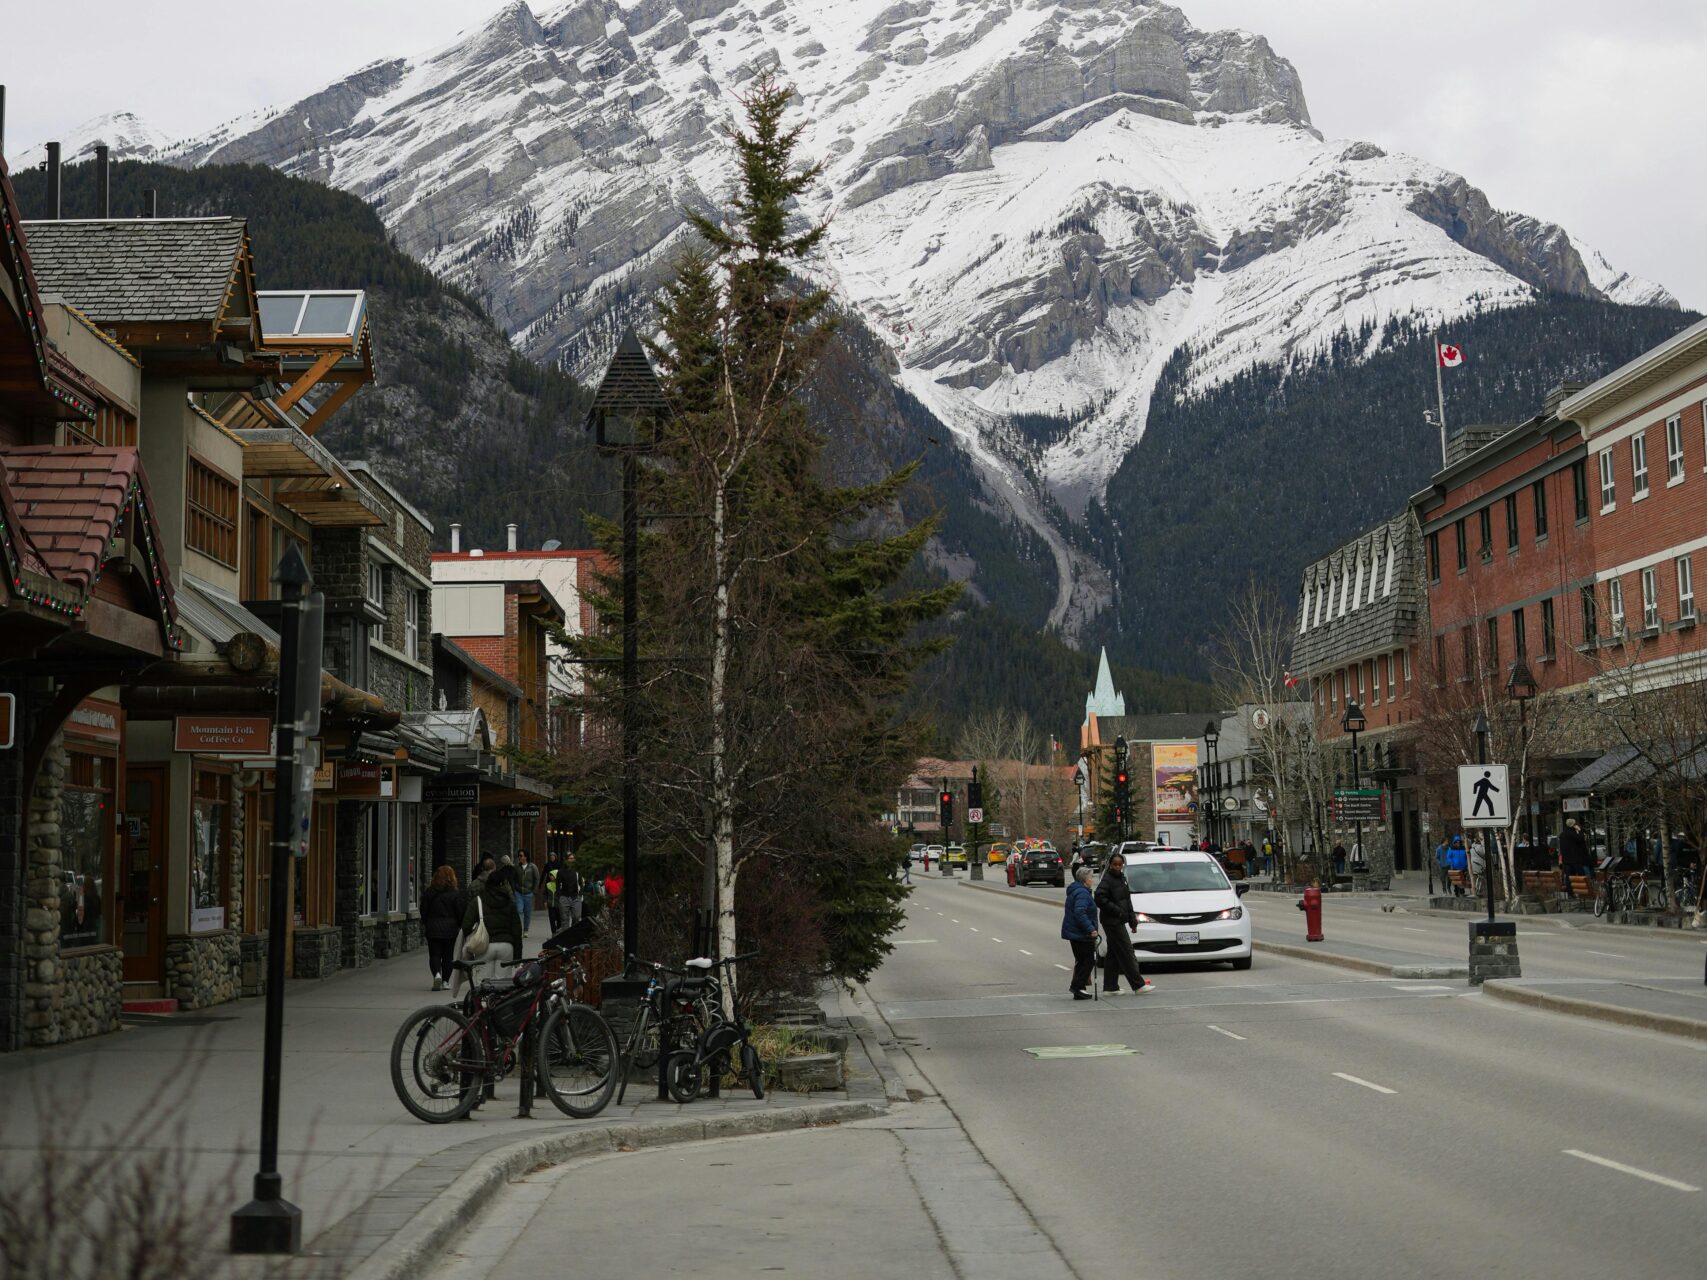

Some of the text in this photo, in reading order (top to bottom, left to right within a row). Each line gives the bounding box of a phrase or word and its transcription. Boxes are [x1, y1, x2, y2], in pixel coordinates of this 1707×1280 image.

[190, 726, 255, 734] Mountain Folk
[199, 735, 244, 744] Coffee Co
